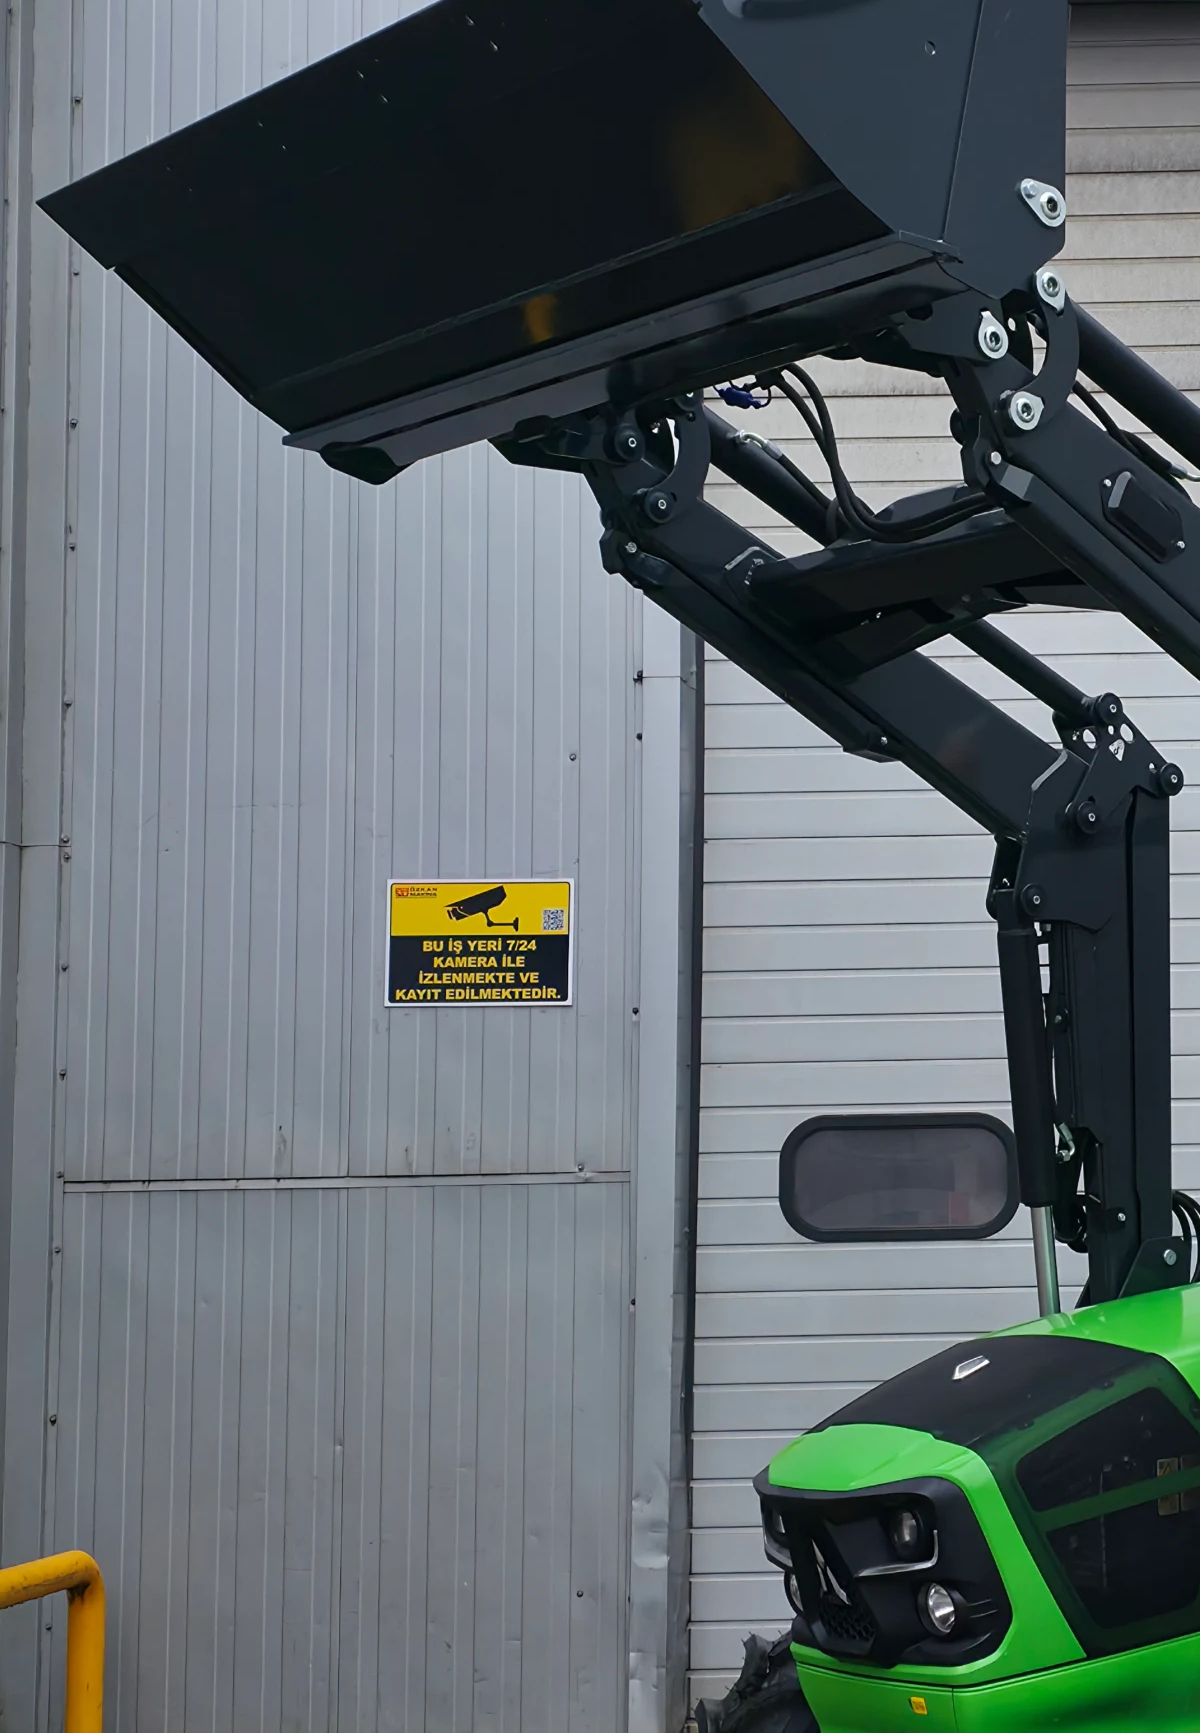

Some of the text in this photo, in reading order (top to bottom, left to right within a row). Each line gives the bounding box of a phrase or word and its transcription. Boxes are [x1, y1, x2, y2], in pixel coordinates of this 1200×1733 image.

[422, 938, 537, 954] BU İŞ YERİ 7/24
[433, 953, 526, 968] KAMERA İLE
[418, 970, 540, 984] İZLENMEKTE VE
[395, 985, 561, 1000] KAYIT EDİLMEKTEDİR.
